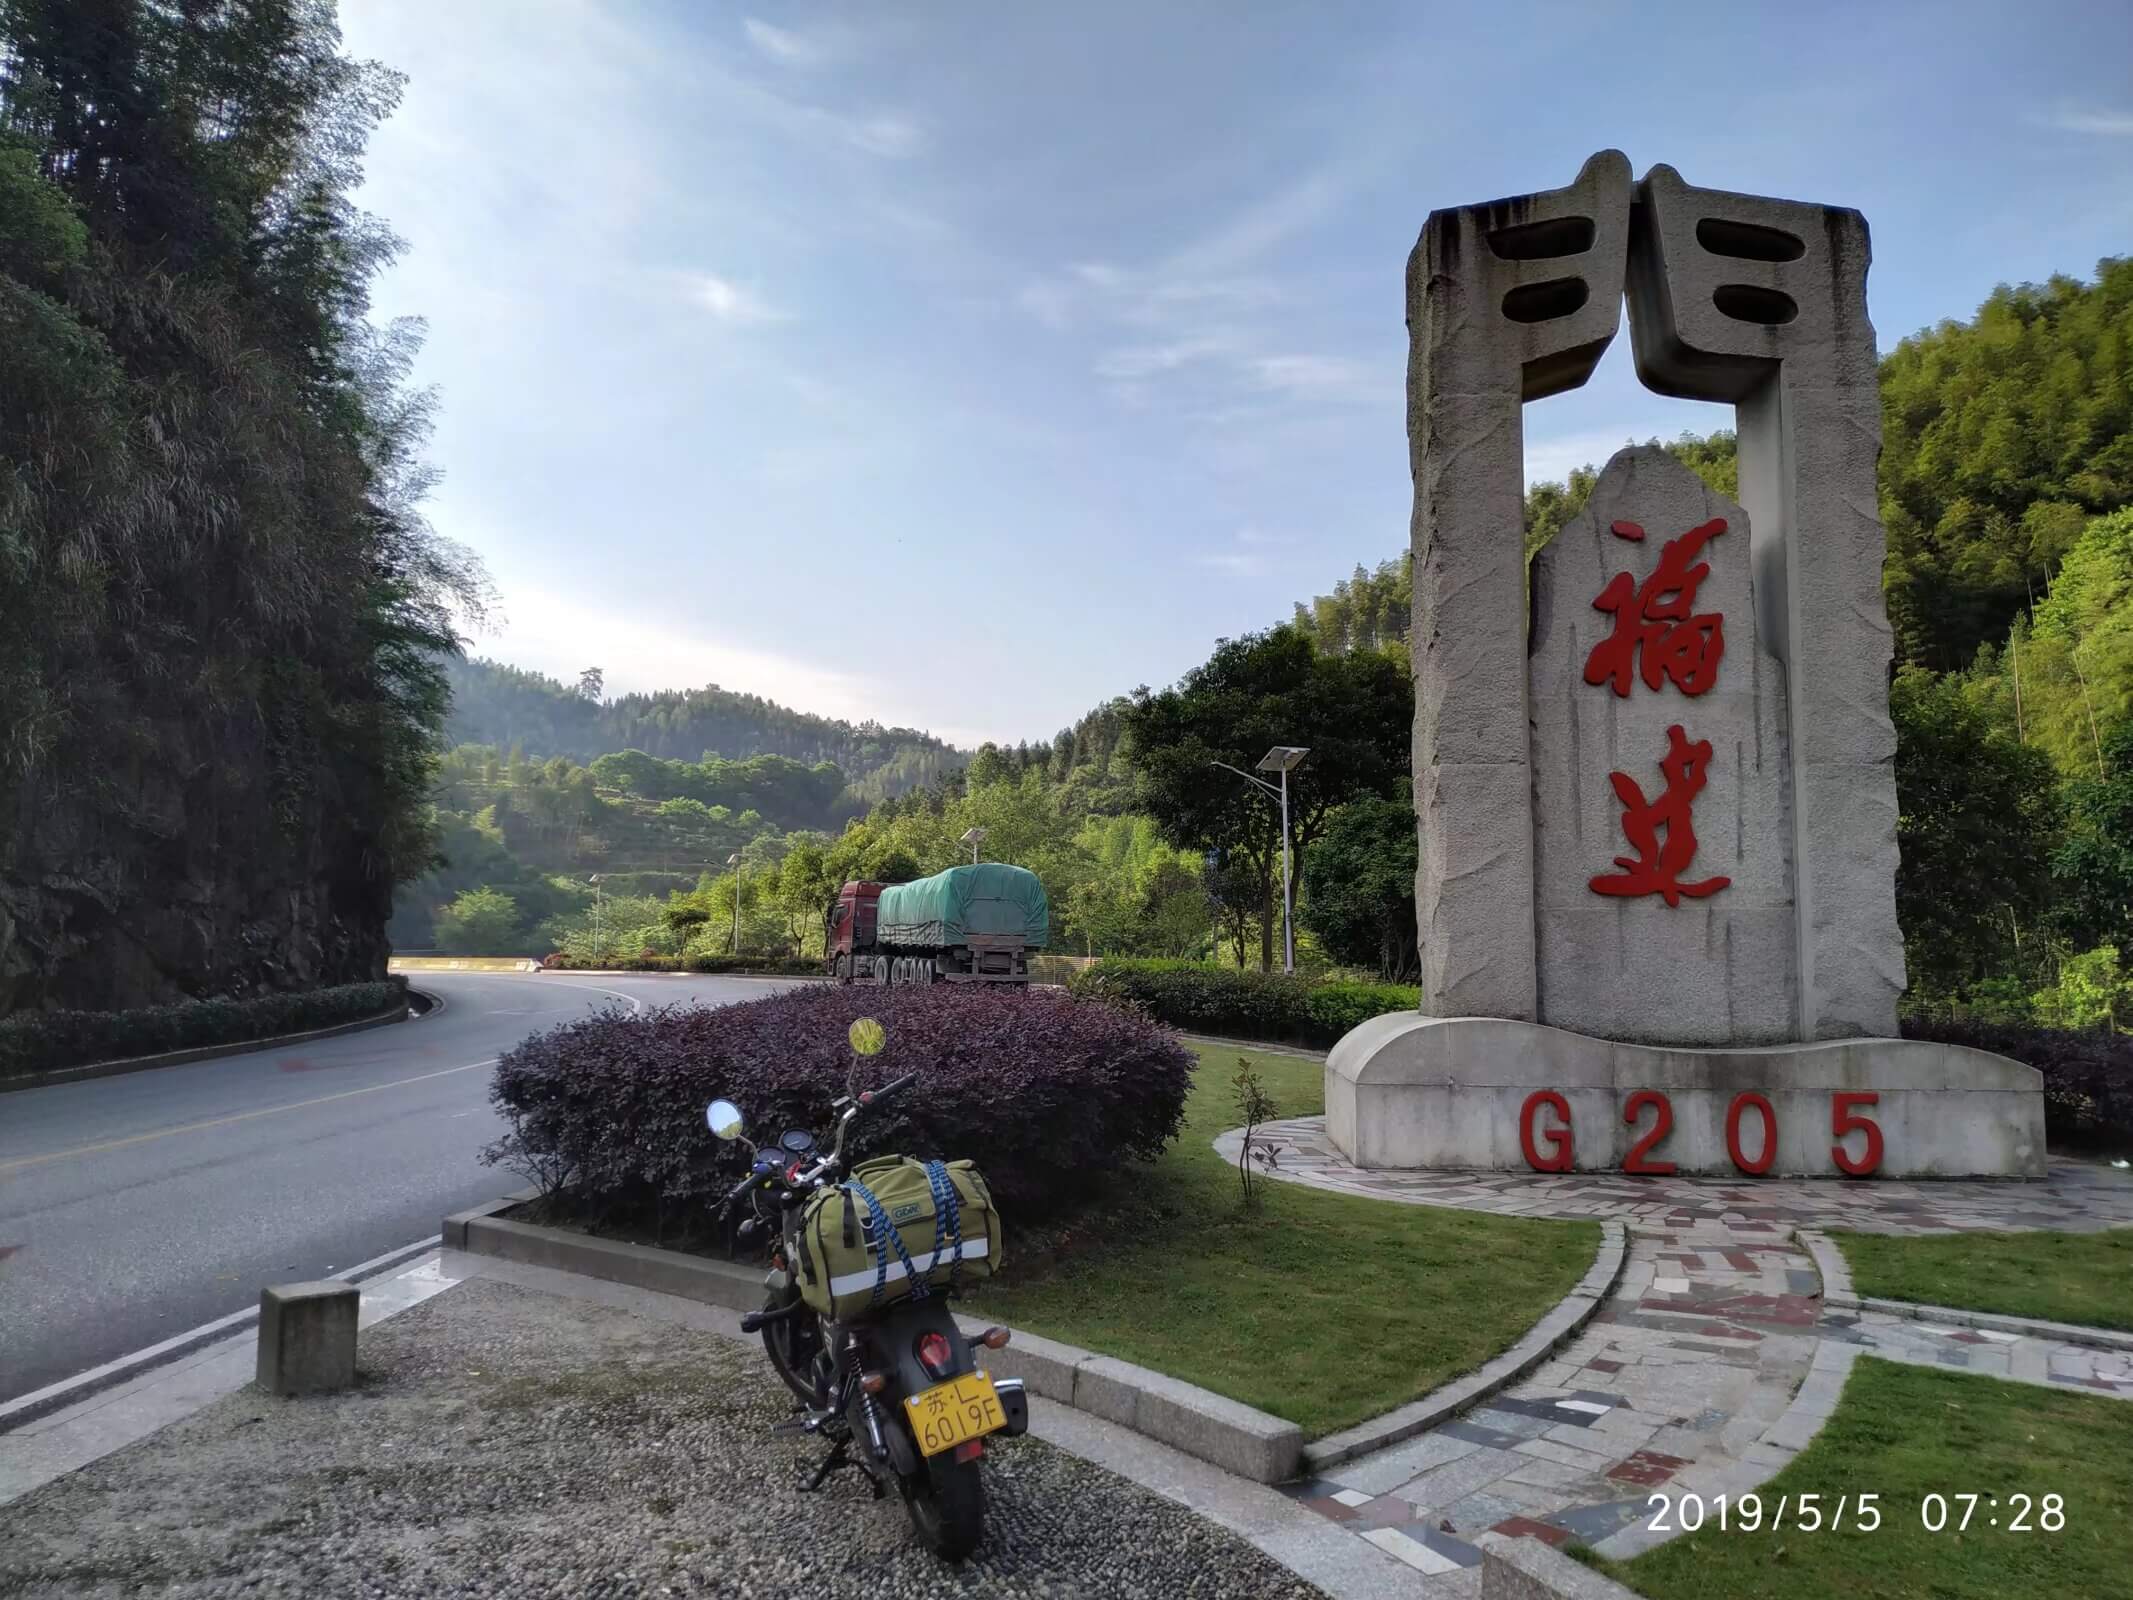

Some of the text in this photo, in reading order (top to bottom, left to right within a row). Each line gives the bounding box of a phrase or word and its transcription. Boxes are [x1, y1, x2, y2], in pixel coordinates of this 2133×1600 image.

[1584, 518, 1730, 906] 福建
[1519, 1090, 1884, 1174] G205
[925, 1397, 997, 1448] 6019F
